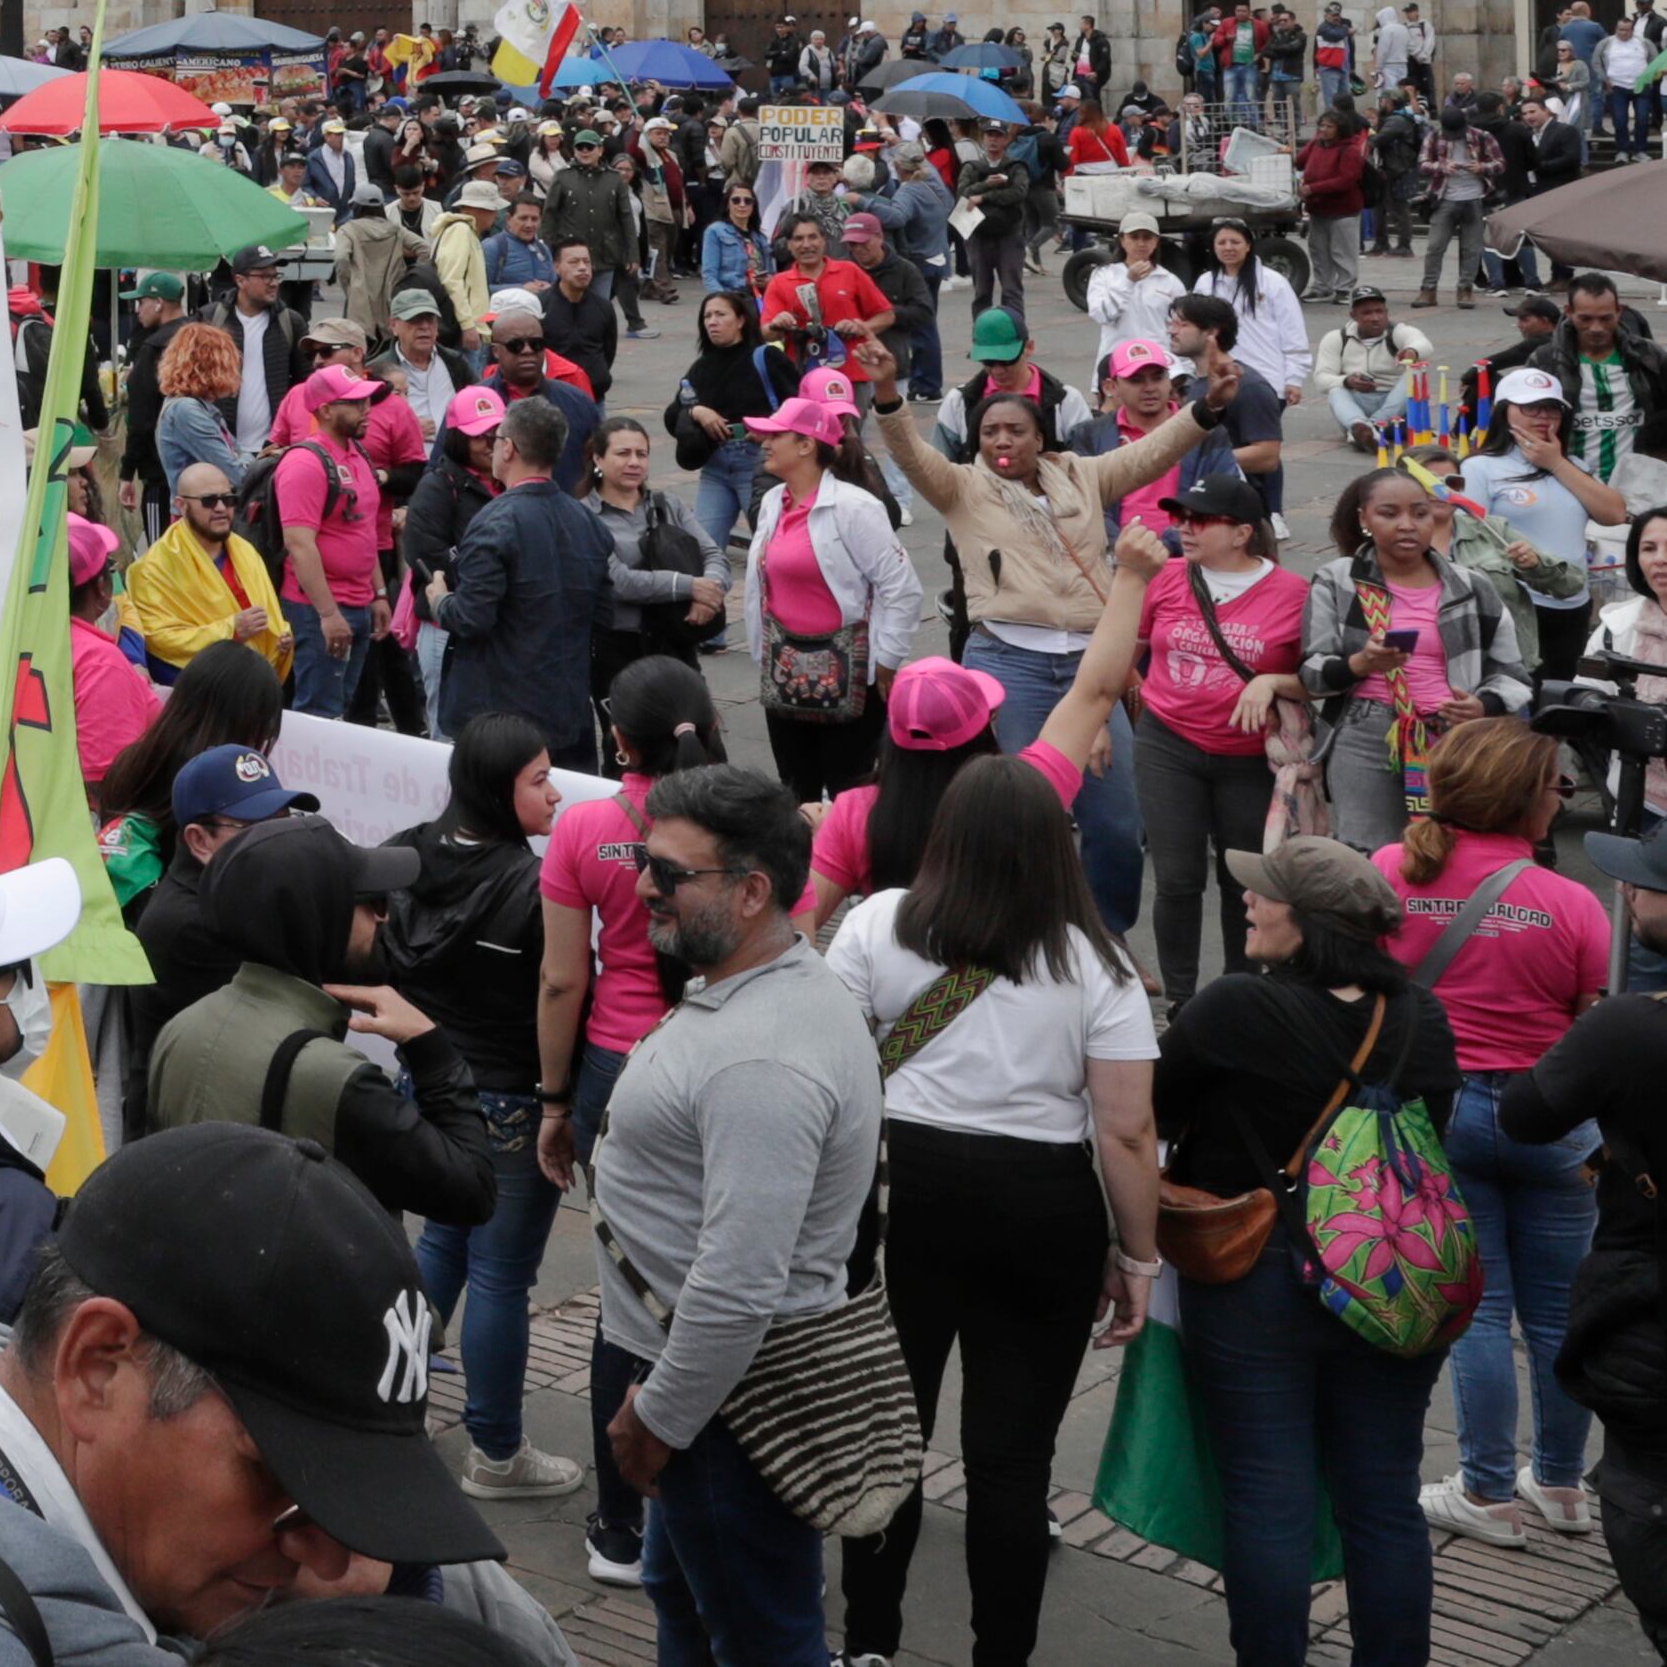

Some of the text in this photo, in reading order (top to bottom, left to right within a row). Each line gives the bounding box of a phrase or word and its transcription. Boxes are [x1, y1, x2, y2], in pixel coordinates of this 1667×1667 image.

[181, 58, 241, 67] AMERICANO
[761, 109, 841, 125] PODER
[760, 127, 843, 143] POPULAR
[759, 144, 843, 160] CONSTITUYENTE
[377, 1289, 433, 1403] NY
